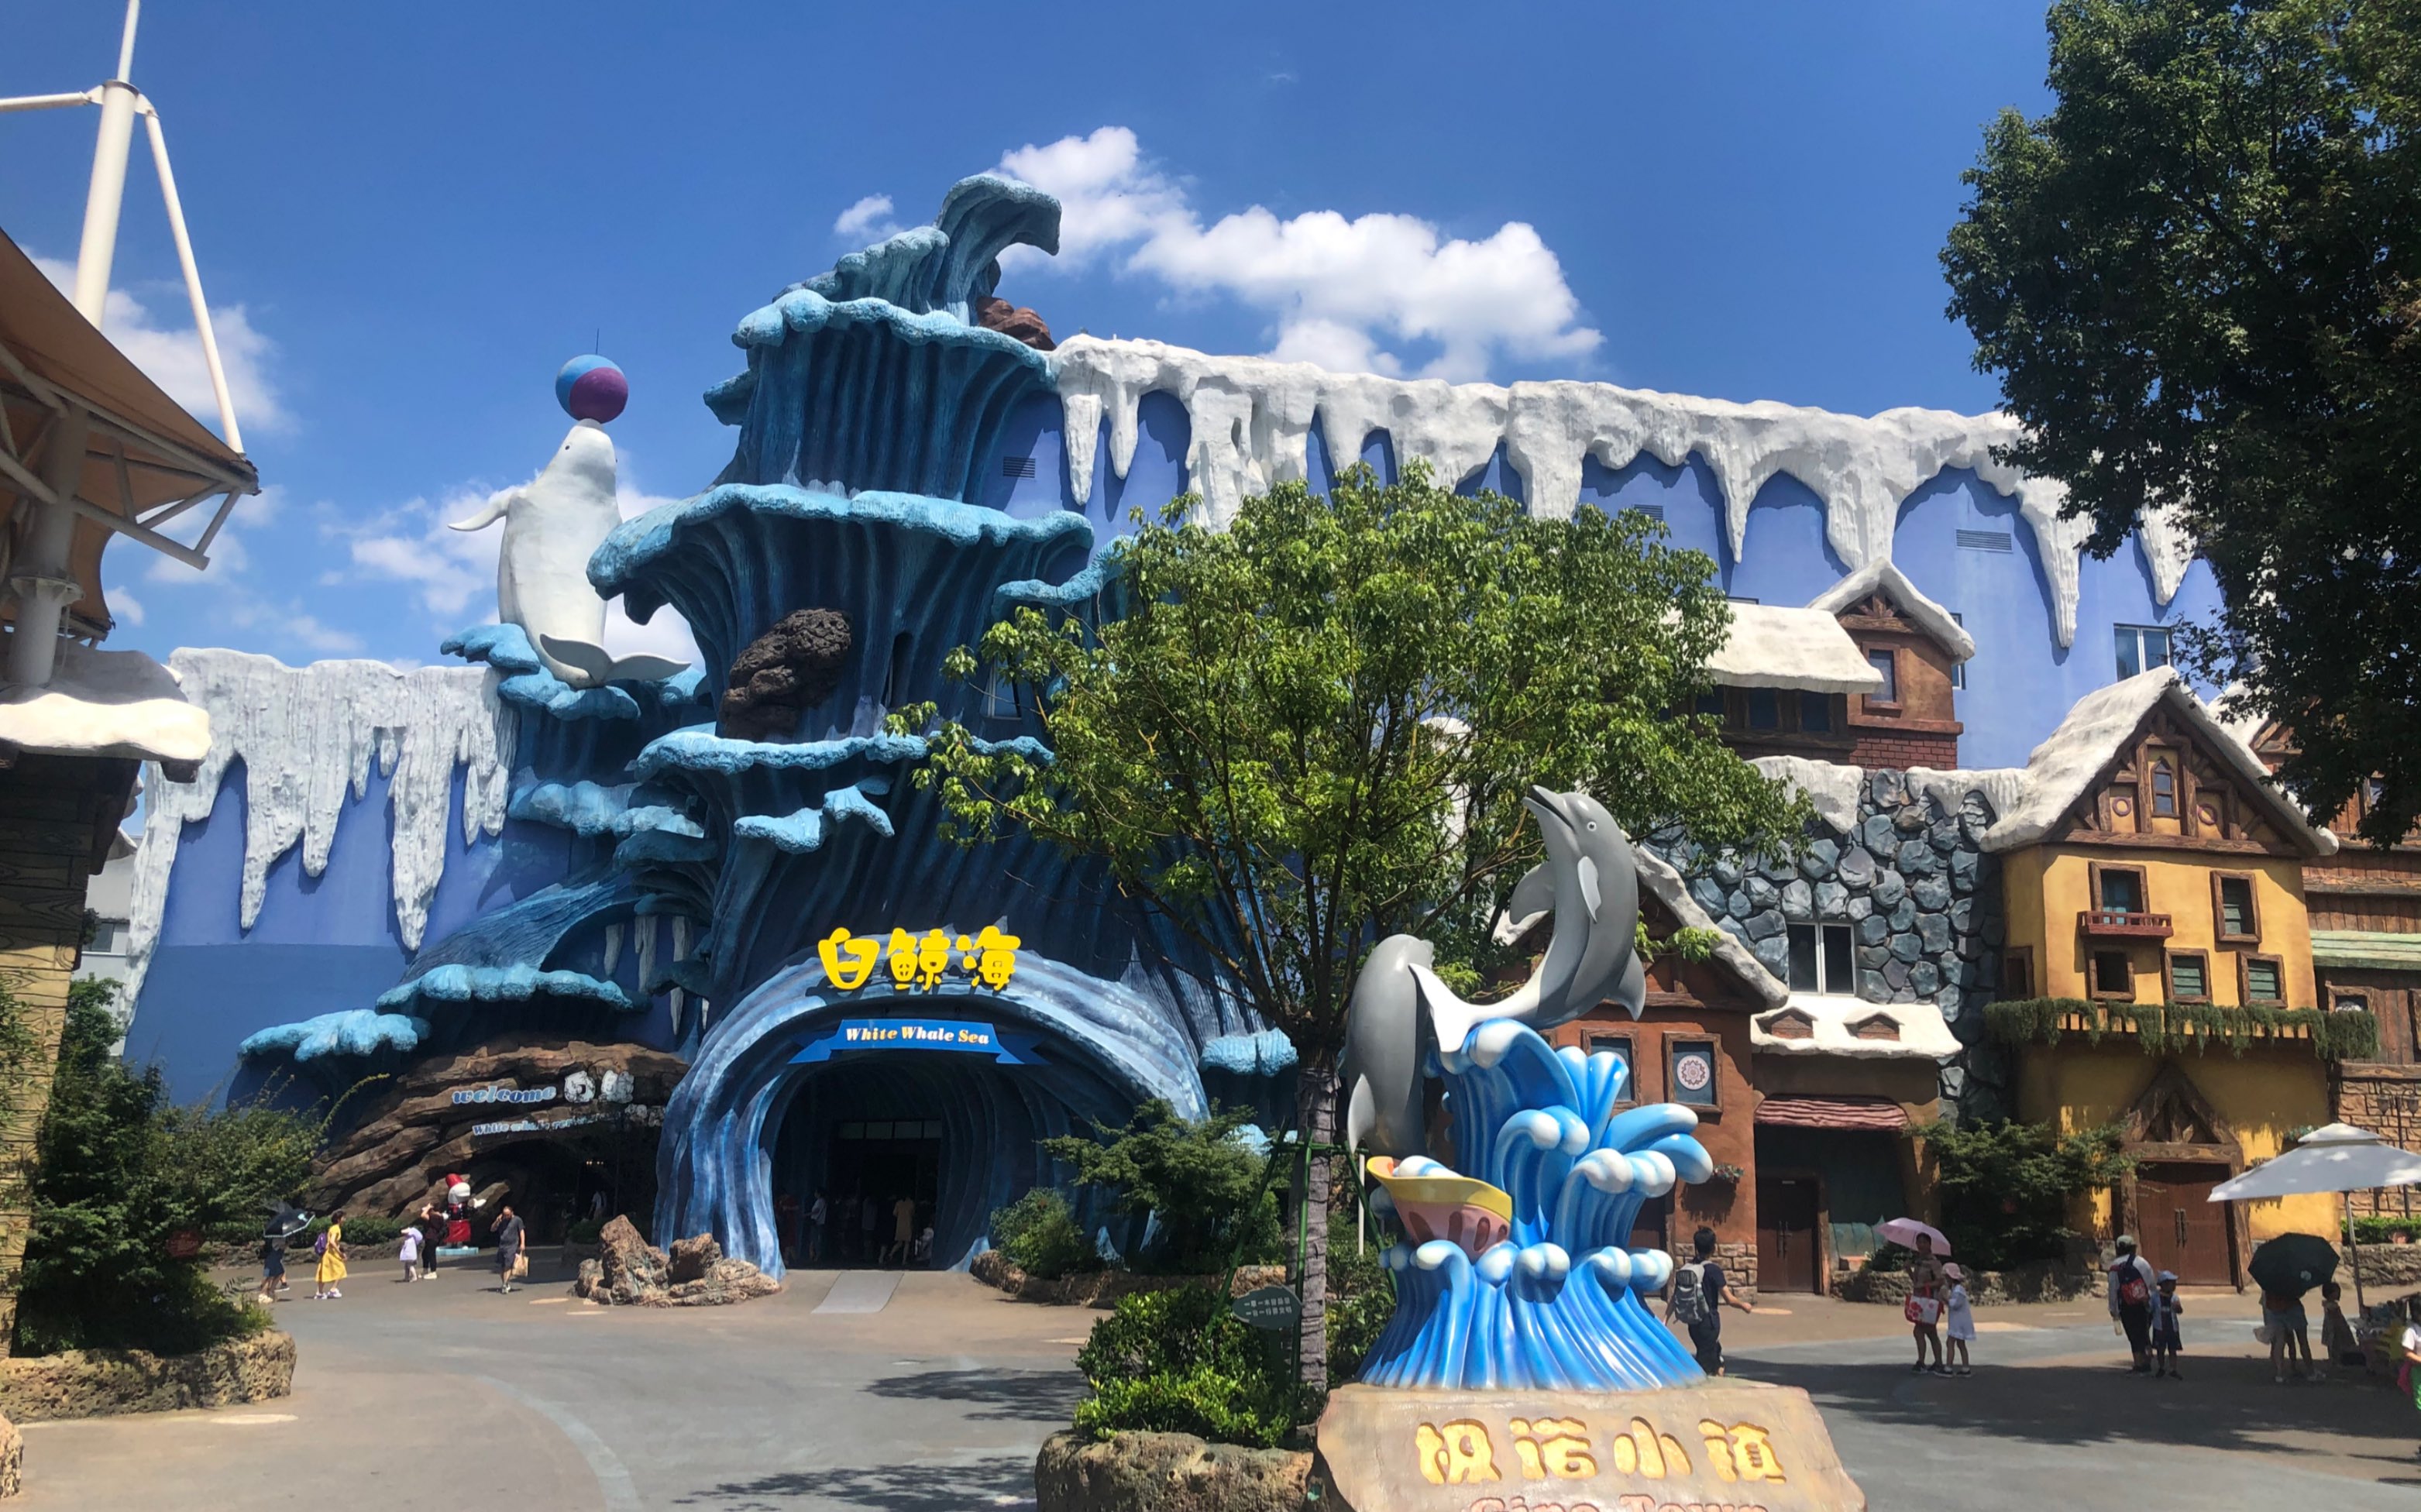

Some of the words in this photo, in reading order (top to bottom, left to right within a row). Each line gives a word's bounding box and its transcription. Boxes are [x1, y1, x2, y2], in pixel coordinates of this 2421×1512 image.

[817, 926, 1021, 991] 白鲸海
[846, 1027, 898, 1042] White
[901, 1026, 954, 1042] Whale
[958, 1029, 989, 1044] Sea
[452, 1085, 556, 1104] welcome
